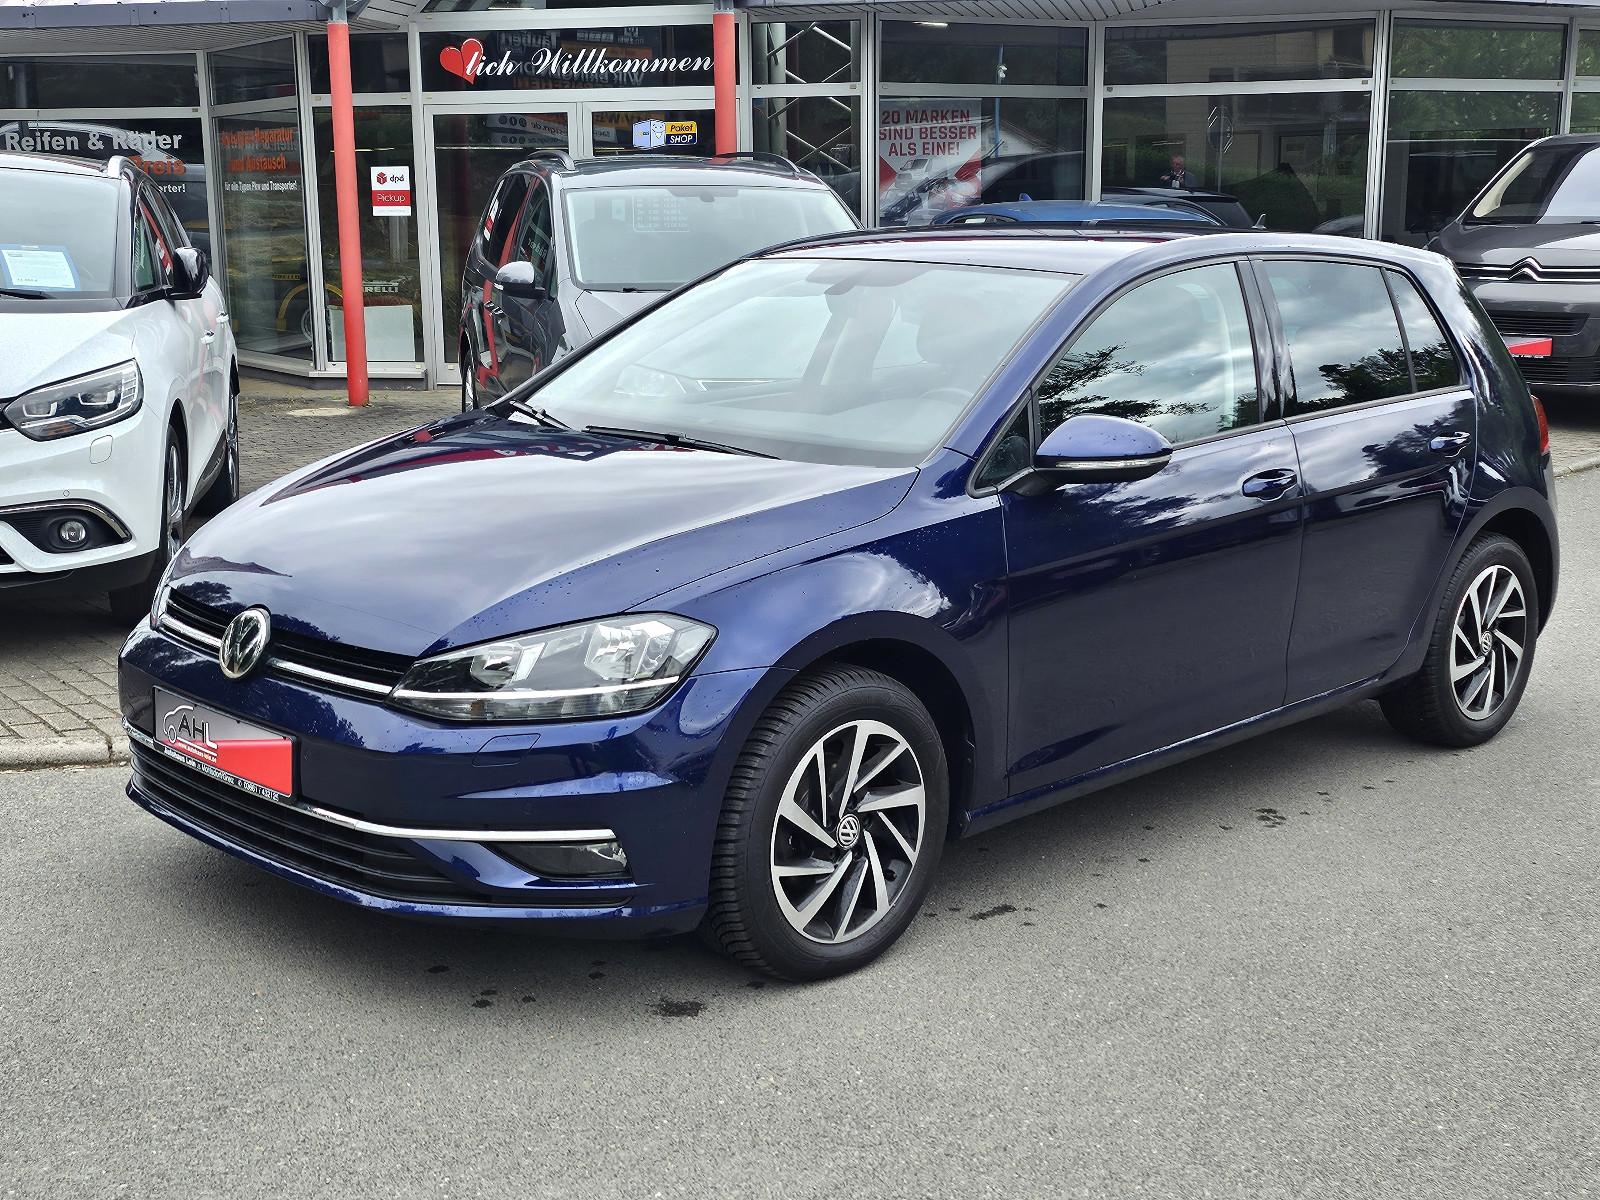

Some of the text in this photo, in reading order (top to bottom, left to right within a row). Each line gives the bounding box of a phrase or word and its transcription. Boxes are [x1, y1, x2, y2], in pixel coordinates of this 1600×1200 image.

[465, 50, 522, 76] lich
[530, 48, 714, 74] Willkommen
[881, 109, 970, 125] 20 MARKEN
[670, 124, 693, 132] Paket
[879, 126, 977, 140] SIND BESSER
[5, 130, 182, 150] Reifen & Räder
[670, 135, 693, 144] SHOP
[888, 141, 960, 156] ALS EINE!
[390, 174, 405, 184] dpd
[377, 193, 406, 203] Pickup
[178, 712, 218, 750] AHL
